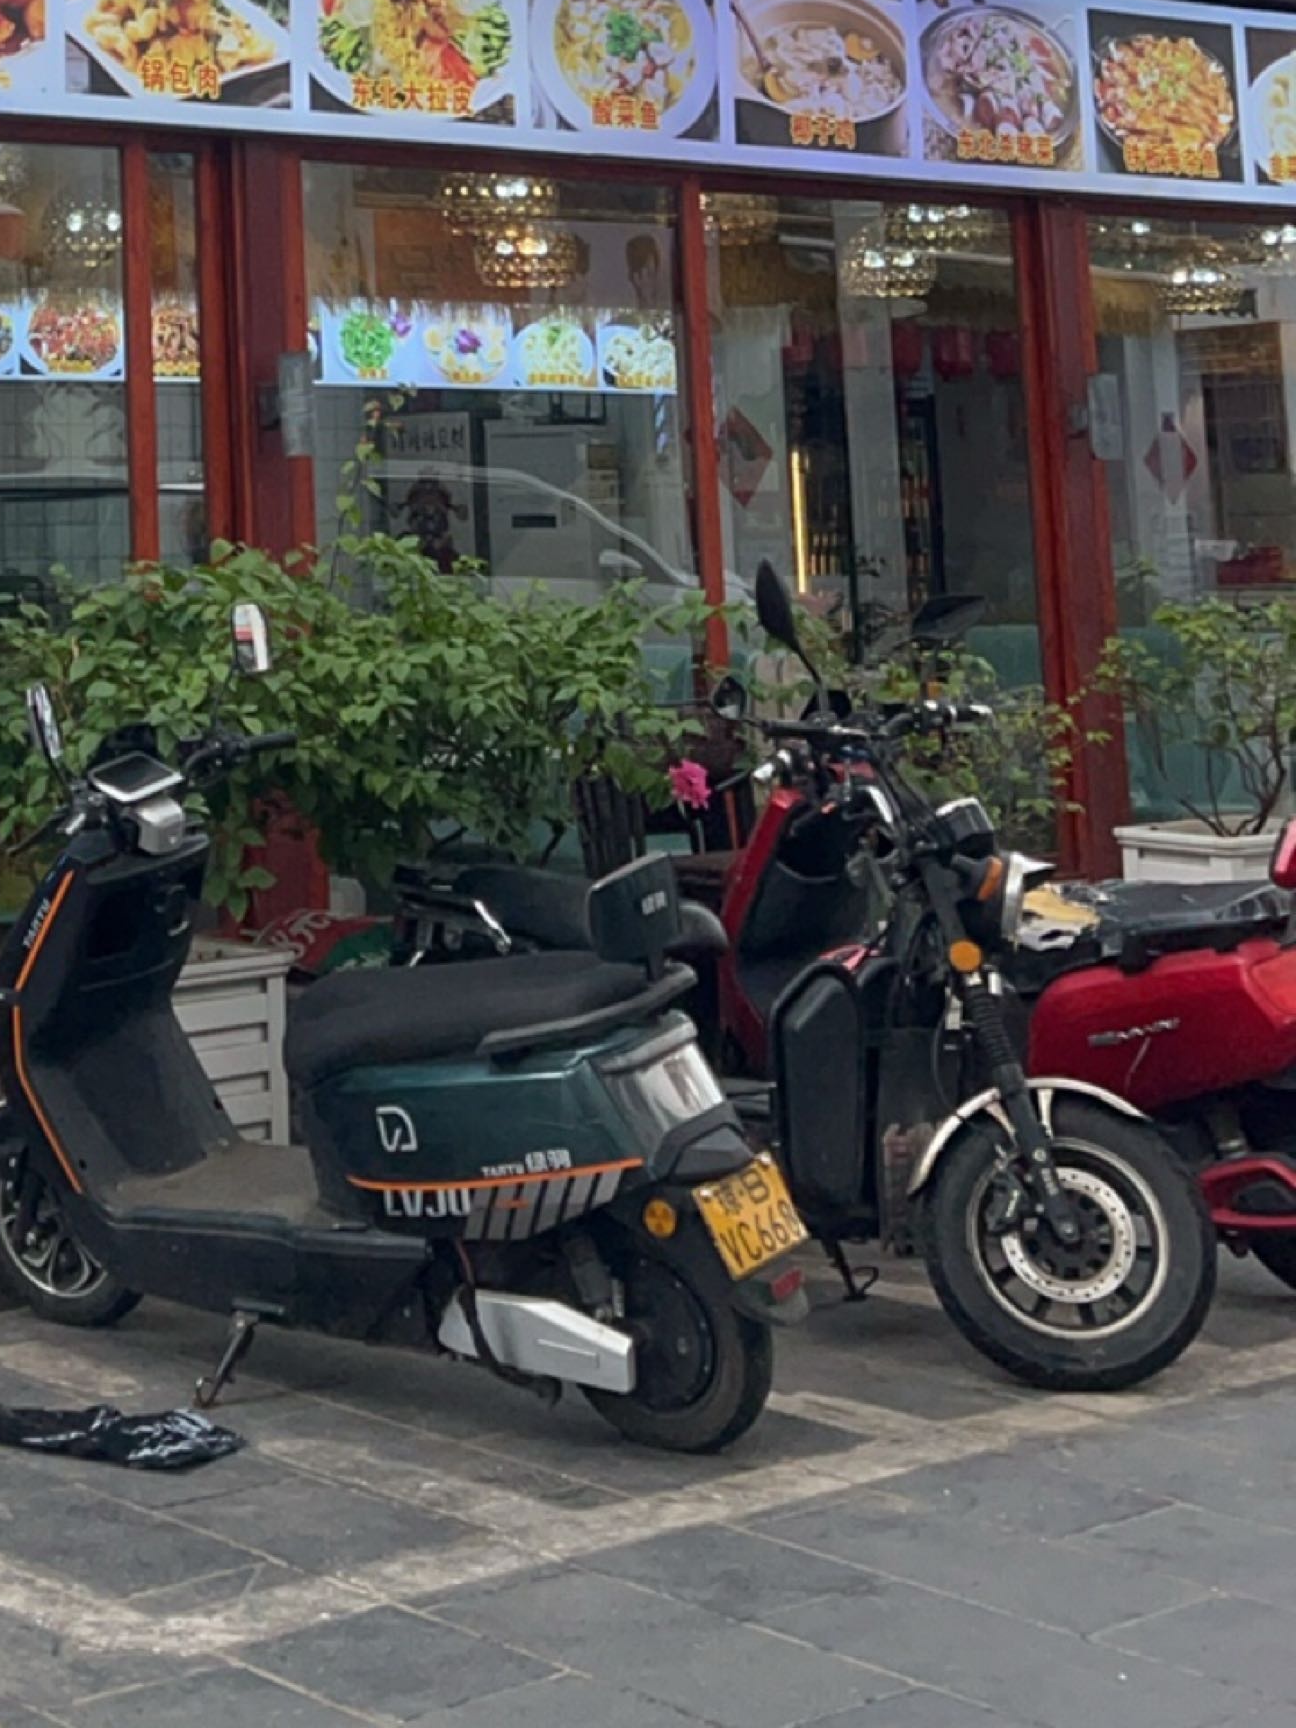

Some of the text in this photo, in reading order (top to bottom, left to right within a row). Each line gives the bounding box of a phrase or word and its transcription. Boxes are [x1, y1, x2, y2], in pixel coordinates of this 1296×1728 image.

[140, 58, 222, 100] 锅包肉
[352, 75, 475, 115] 东北大拉皮
[591, 92, 660, 130] 酸菜鱼
